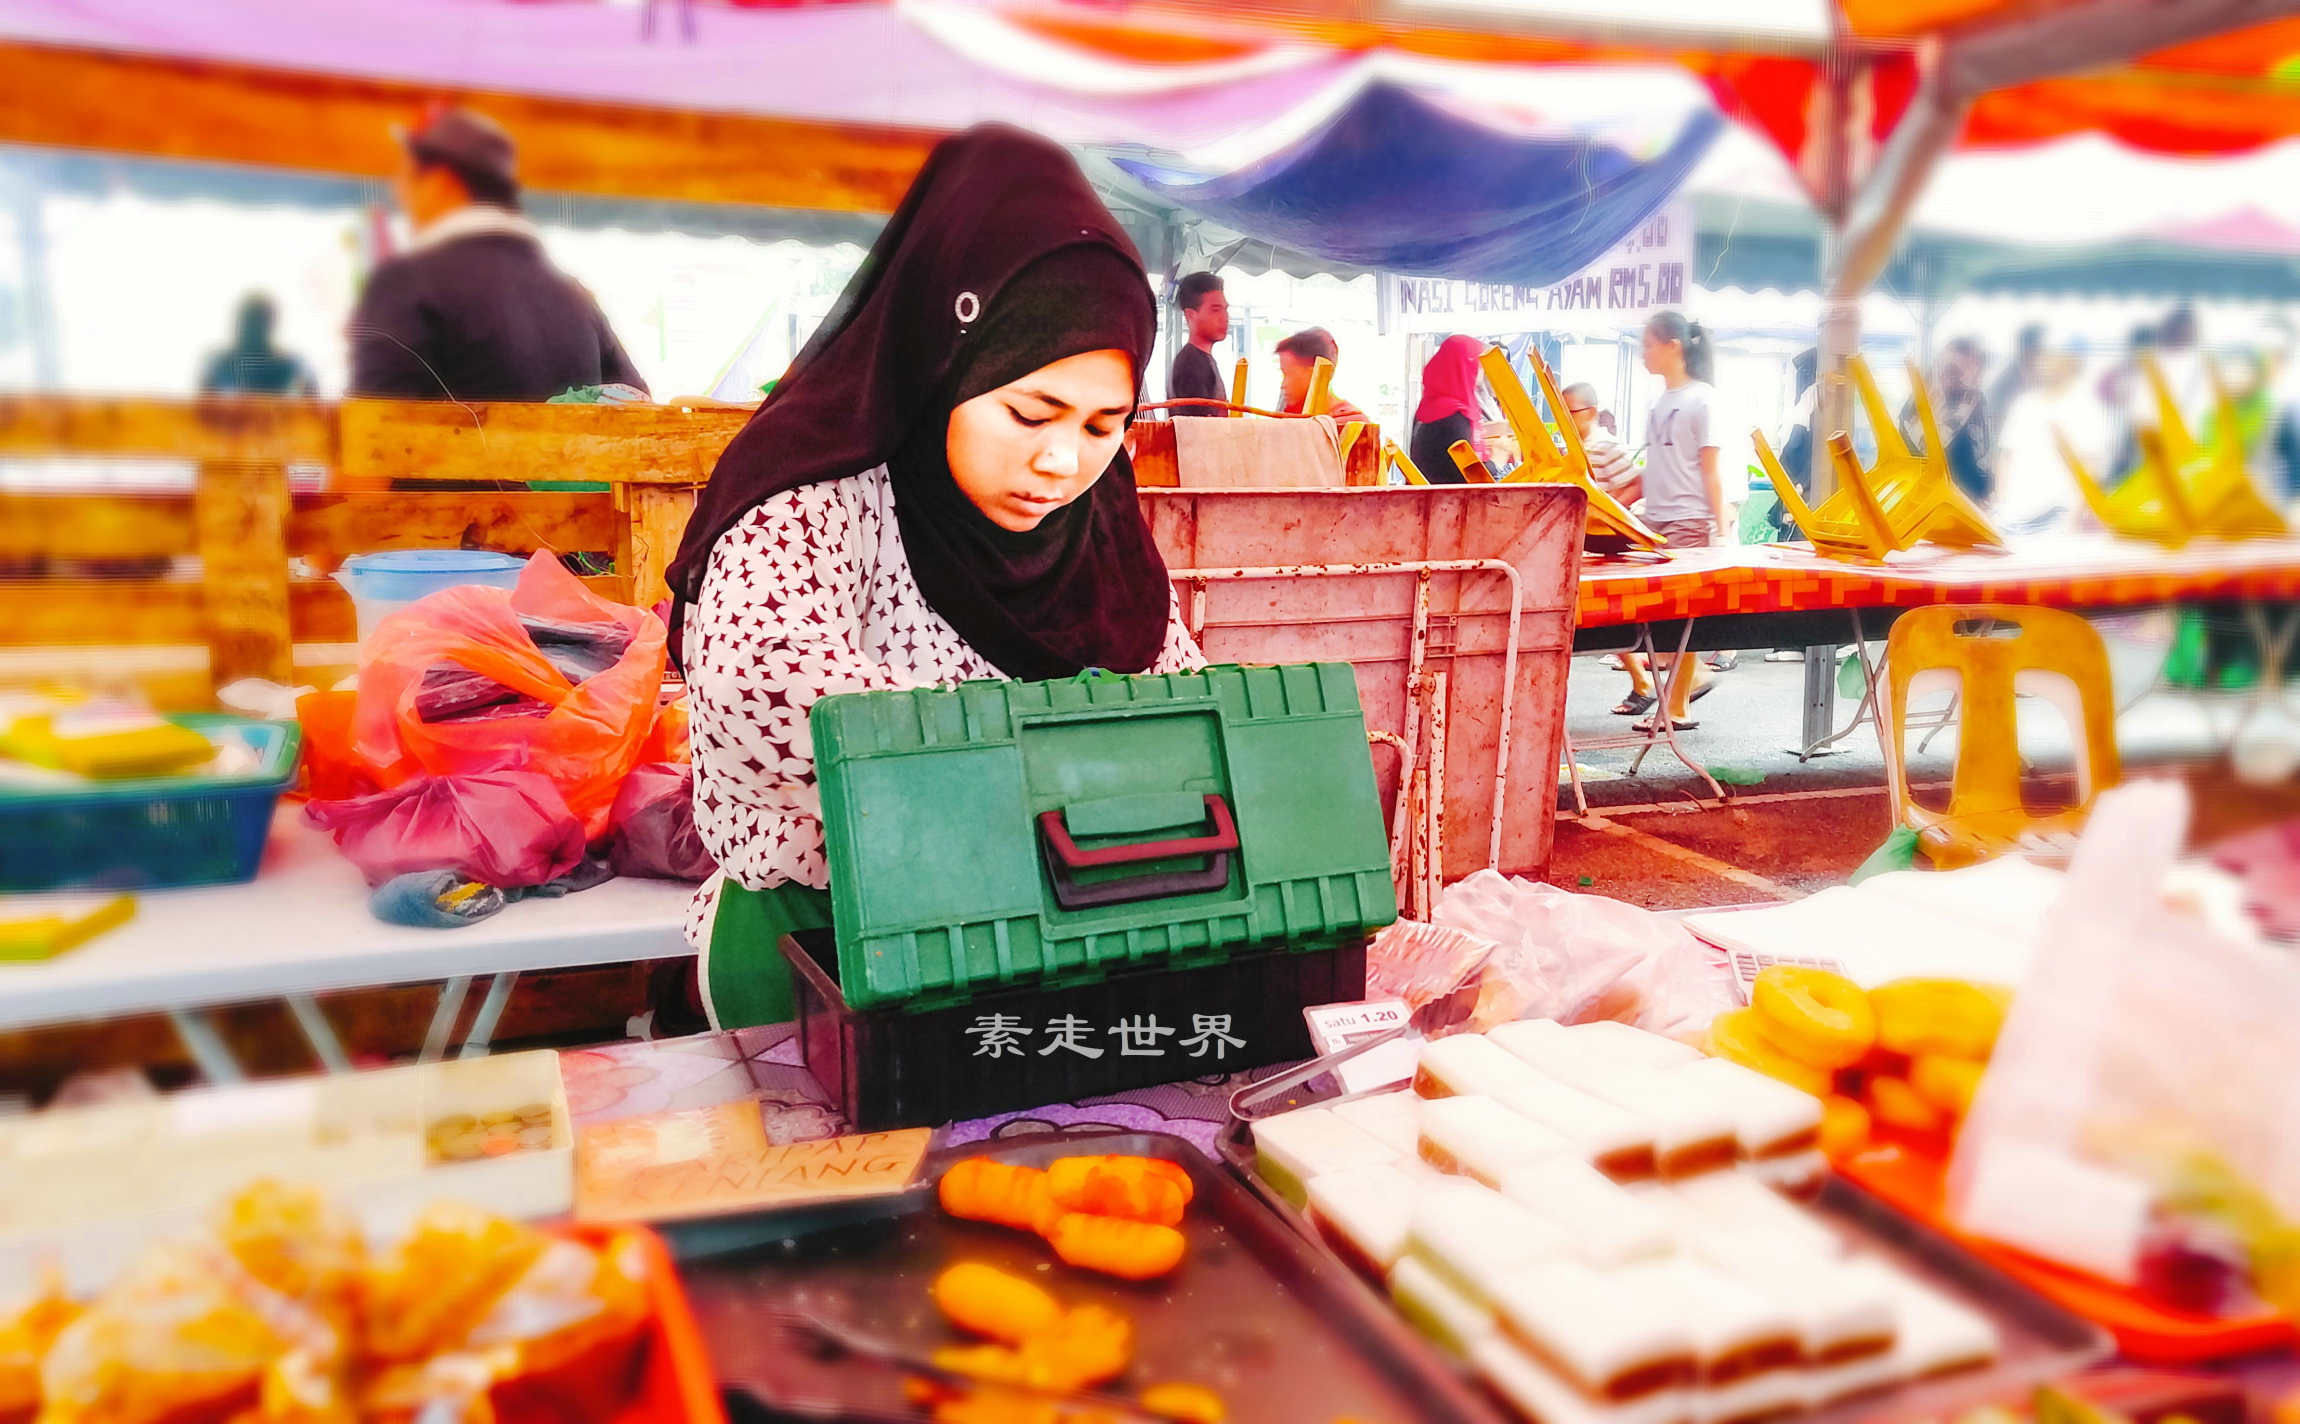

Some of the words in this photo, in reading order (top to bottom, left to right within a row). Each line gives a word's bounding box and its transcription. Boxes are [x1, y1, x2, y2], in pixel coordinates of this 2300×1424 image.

[1400, 279, 1454, 314] NASI
[1547, 277, 1602, 311] AYAM
[1608, 262, 1684, 309] RM5.00
[1324, 1017, 1356, 1029] satu
[1361, 1010, 1398, 1023] 1.20
